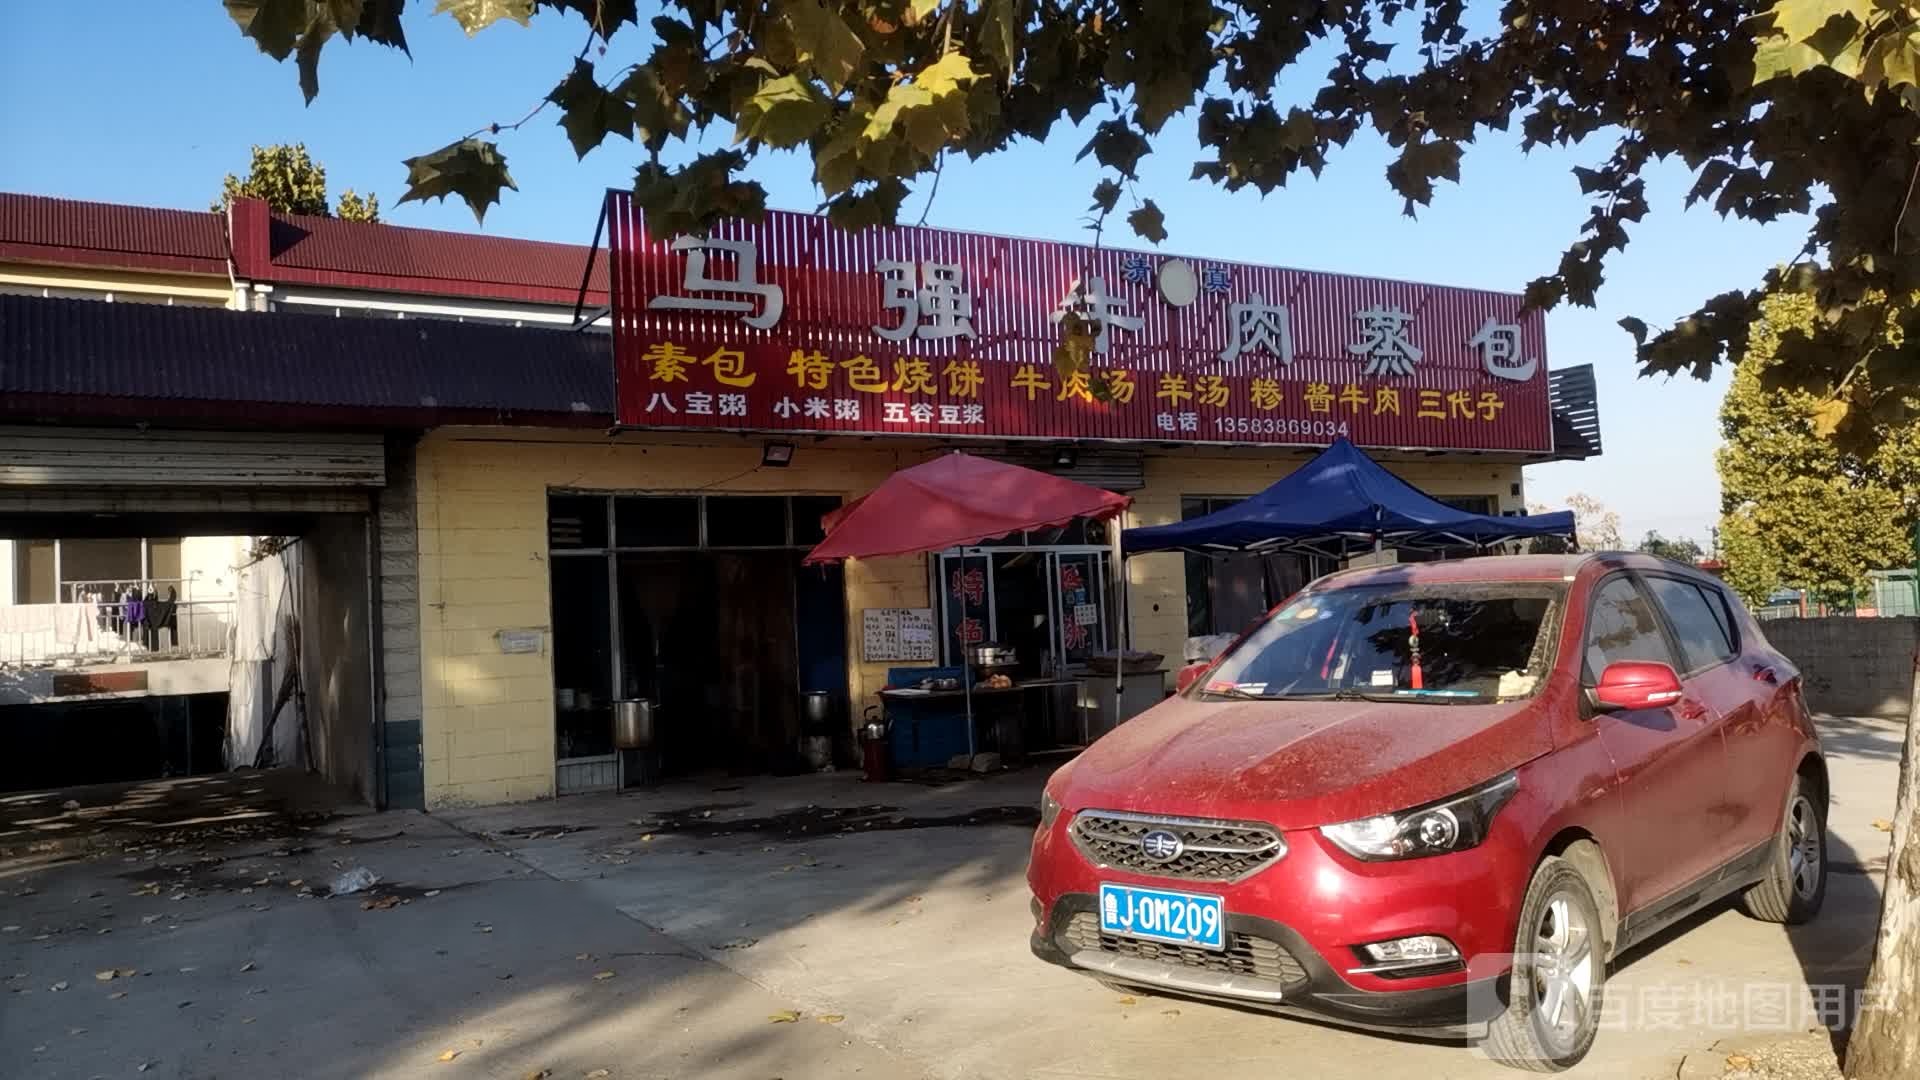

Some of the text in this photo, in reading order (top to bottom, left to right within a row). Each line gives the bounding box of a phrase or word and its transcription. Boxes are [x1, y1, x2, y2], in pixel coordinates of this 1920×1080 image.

[1120, 256, 1232, 293] 清真
[648, 233, 1537, 382] 马强牛肉蒸包
[642, 341, 757, 387] 素包
[786, 348, 985, 398] 特色烧饼
[1010, 364, 1135, 403] 牛肉汤
[1156, 372, 1231, 408] 羊汤
[1303, 382, 1401, 415] 酱牛肉
[1417, 390, 1505, 421] 三代子
[645, 391, 985, 424] 八宝粥 小米粥 五谷豆浆
[1156, 412, 1349, 438] 电话 13583869034
